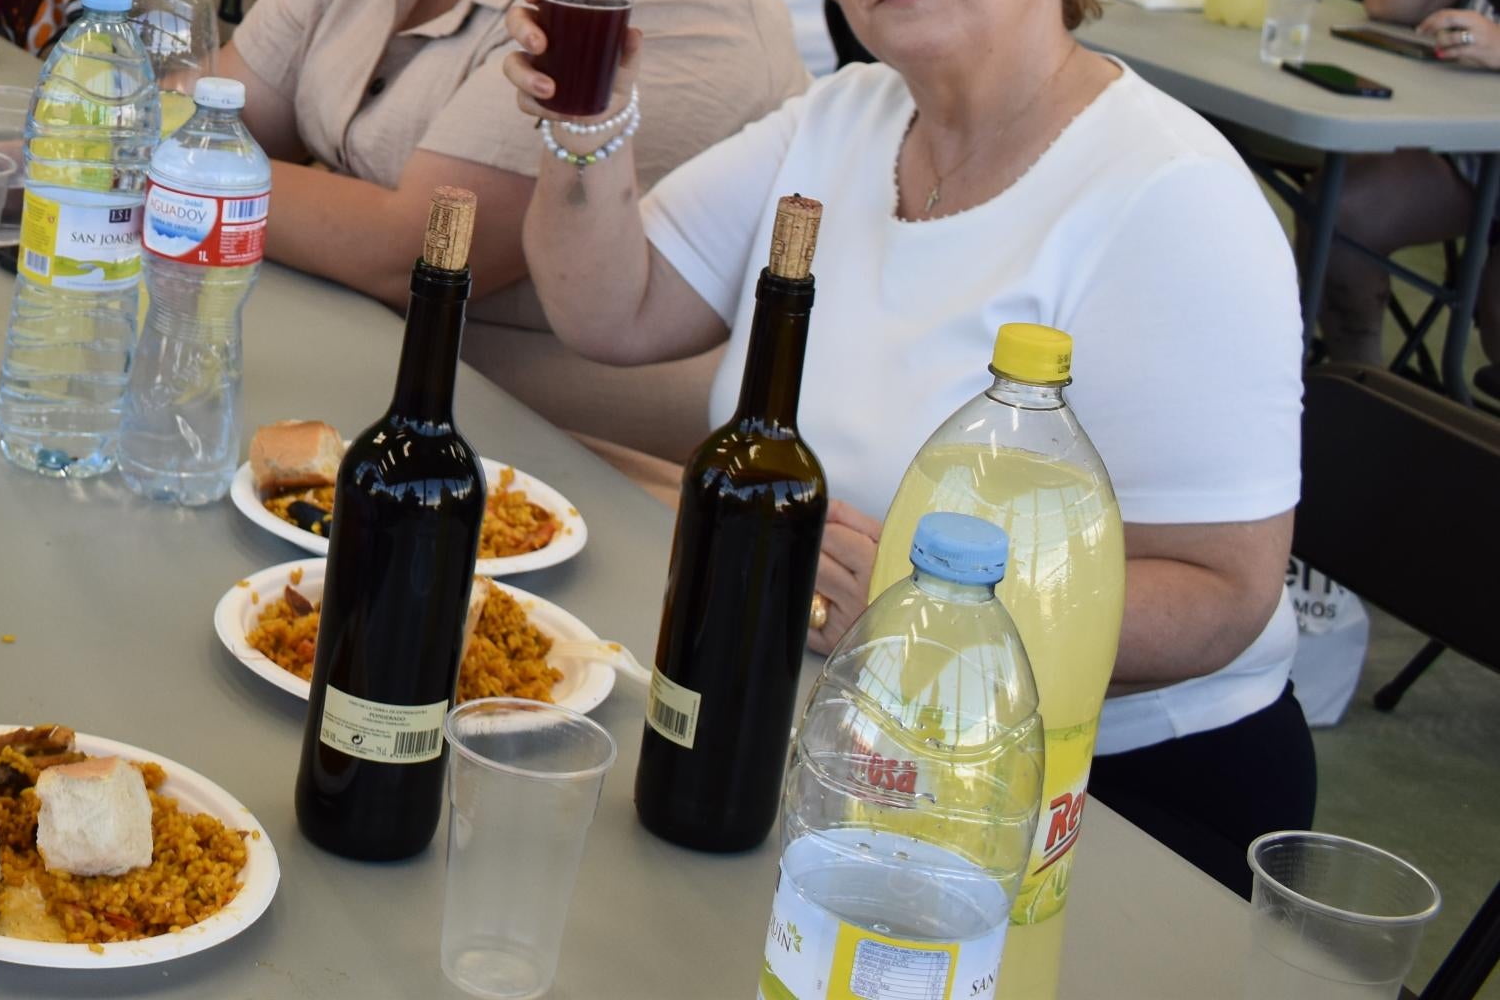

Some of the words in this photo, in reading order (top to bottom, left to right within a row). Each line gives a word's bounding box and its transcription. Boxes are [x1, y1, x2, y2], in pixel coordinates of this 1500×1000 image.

[70, 231, 97, 245] SAN
[198, 250, 209, 262] 1L
[970, 968, 996, 997] SAN
